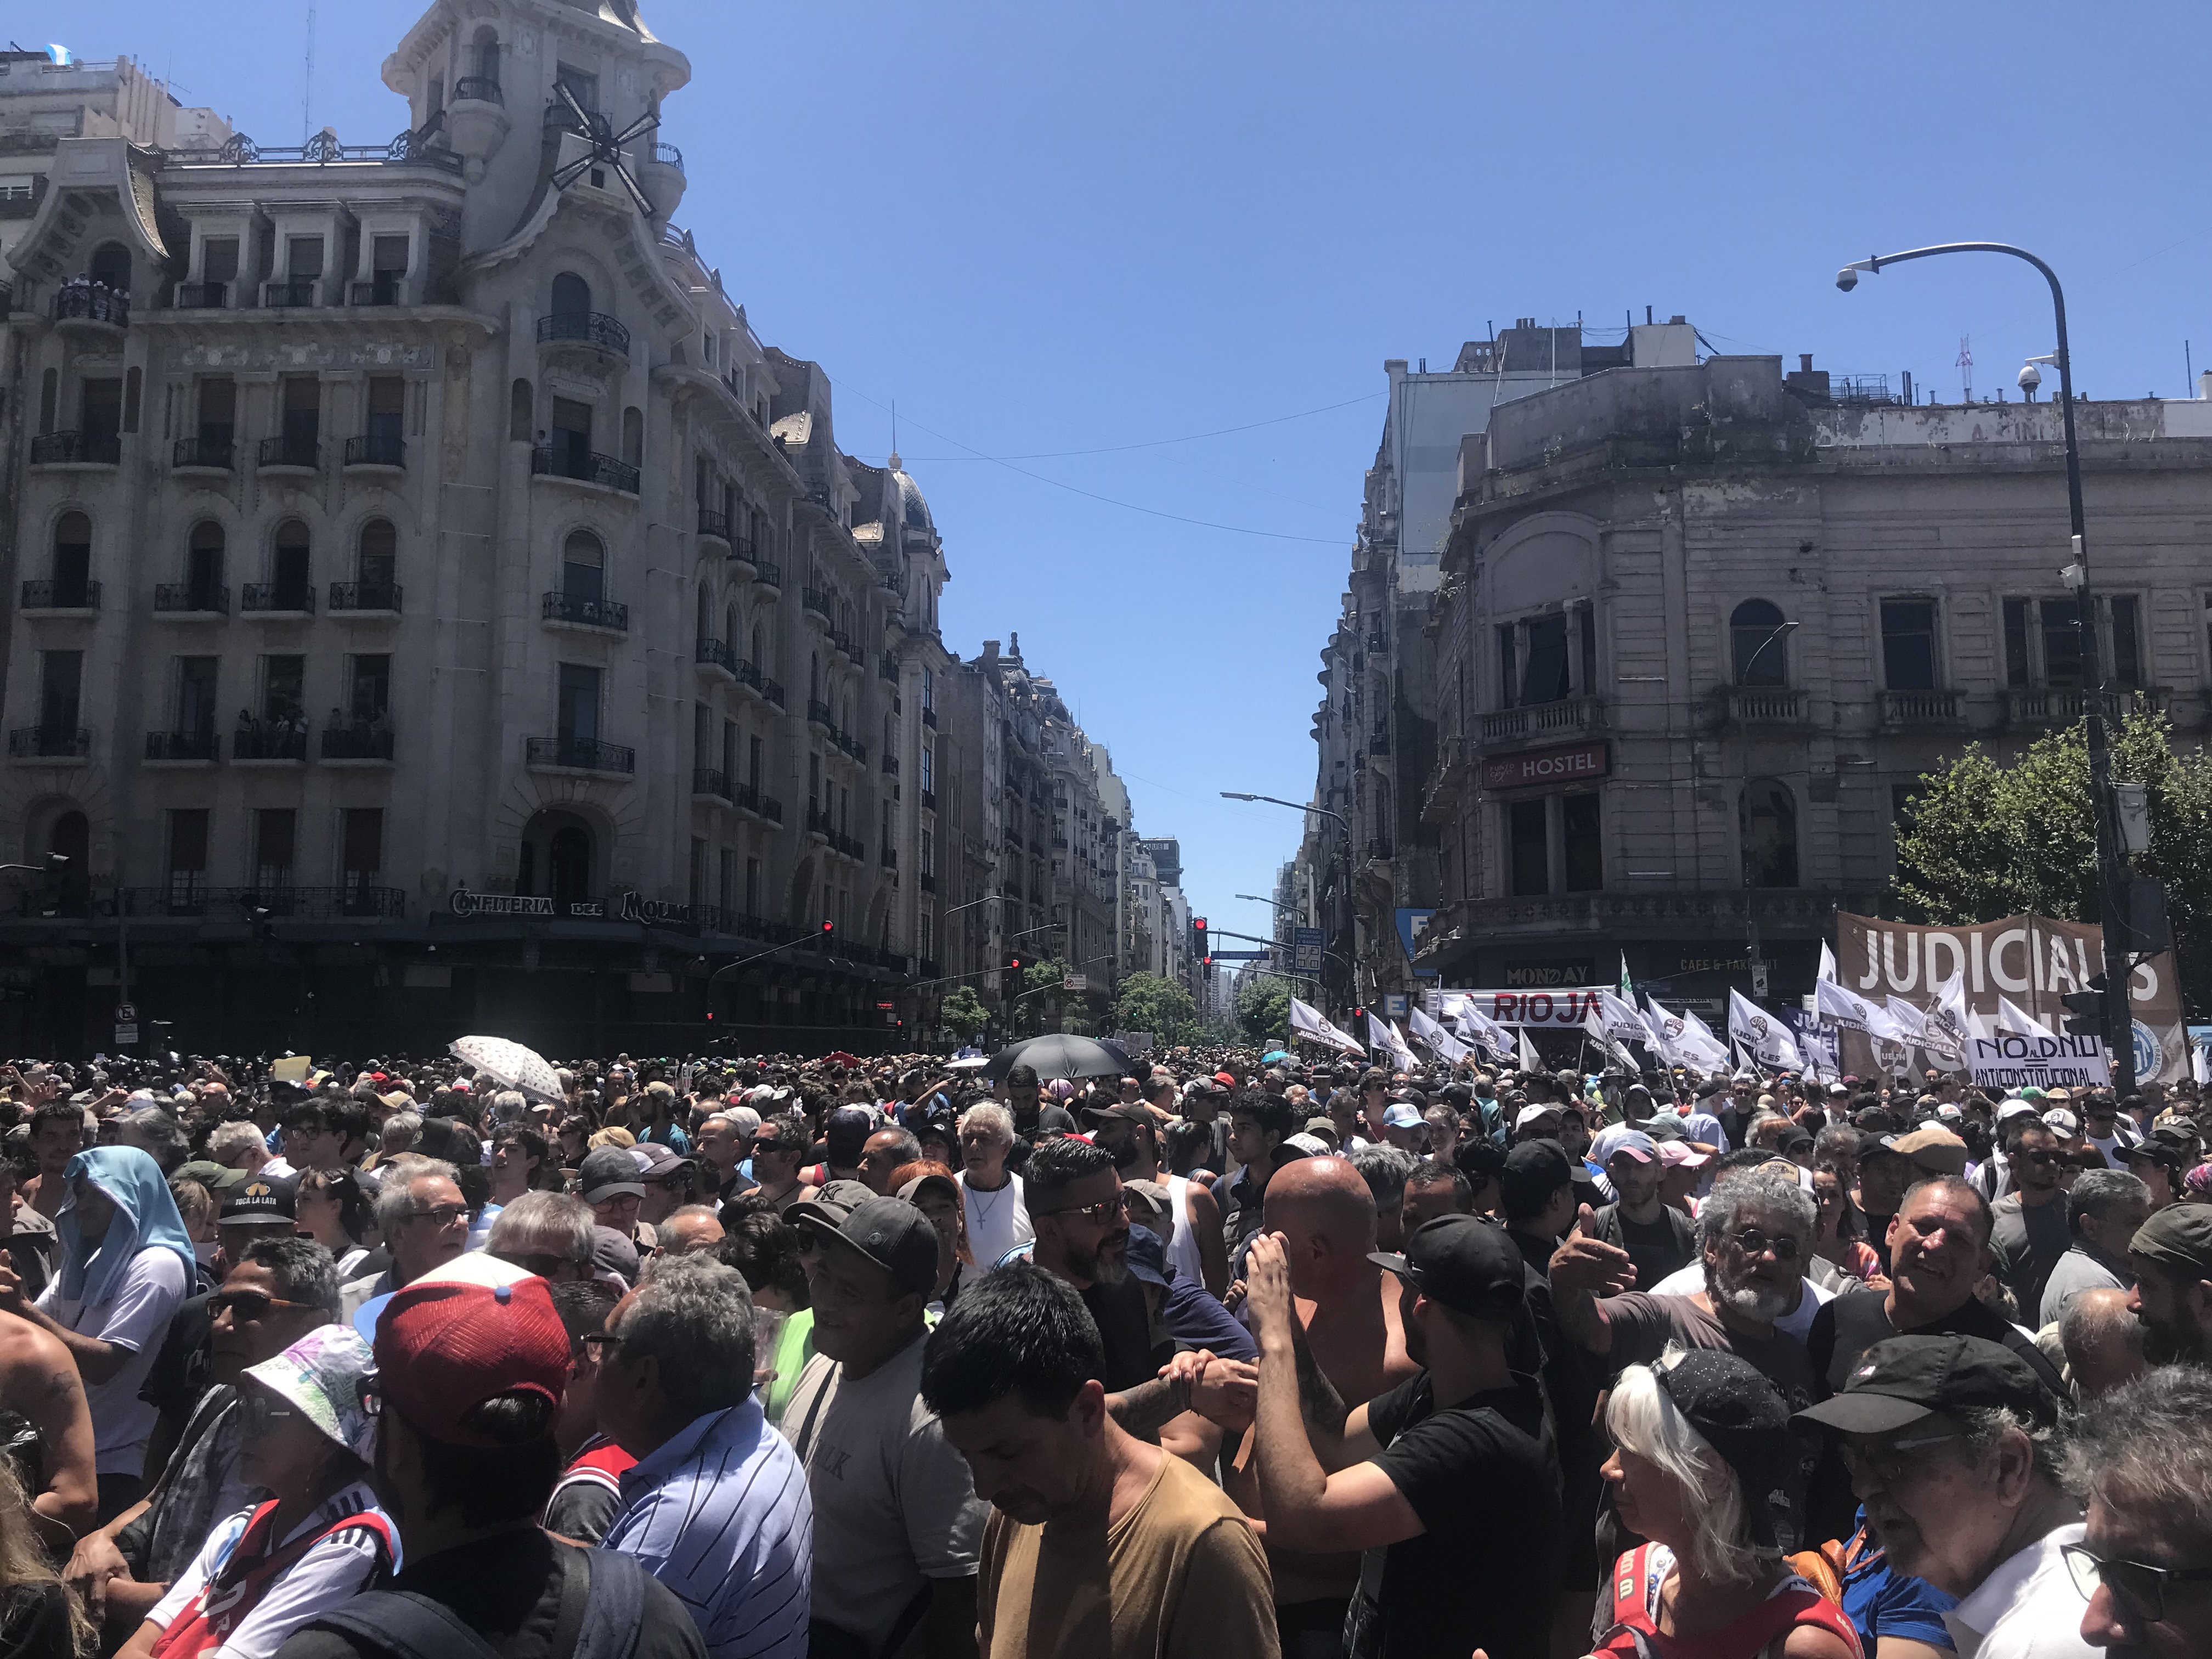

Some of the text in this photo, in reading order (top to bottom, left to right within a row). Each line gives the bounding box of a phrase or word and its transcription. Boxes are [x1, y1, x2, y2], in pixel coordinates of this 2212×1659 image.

[1523, 753, 1596, 776] HOSTEL
[571, 903, 604, 916] DEL
[621, 891, 691, 924] MOLINO
[1507, 967, 1589, 984] MONDAY
[1680, 960, 1709, 970] CAFE
[1860, 929, 2158, 1001] JUDICIALS
[1387, 996, 1404, 1014] E
[1493, 992, 1602, 1023] RIOJA
[1297, 1030, 1347, 1049] JUDICIALES
[1976, 1037, 2028, 1058] NO
[2030, 1049, 2040, 1058] AL
[2152, 1044, 2162, 1074] TRABAJO
[235, 1197, 250, 1206] TOCA
[261, 1197, 276, 1205] LATA
